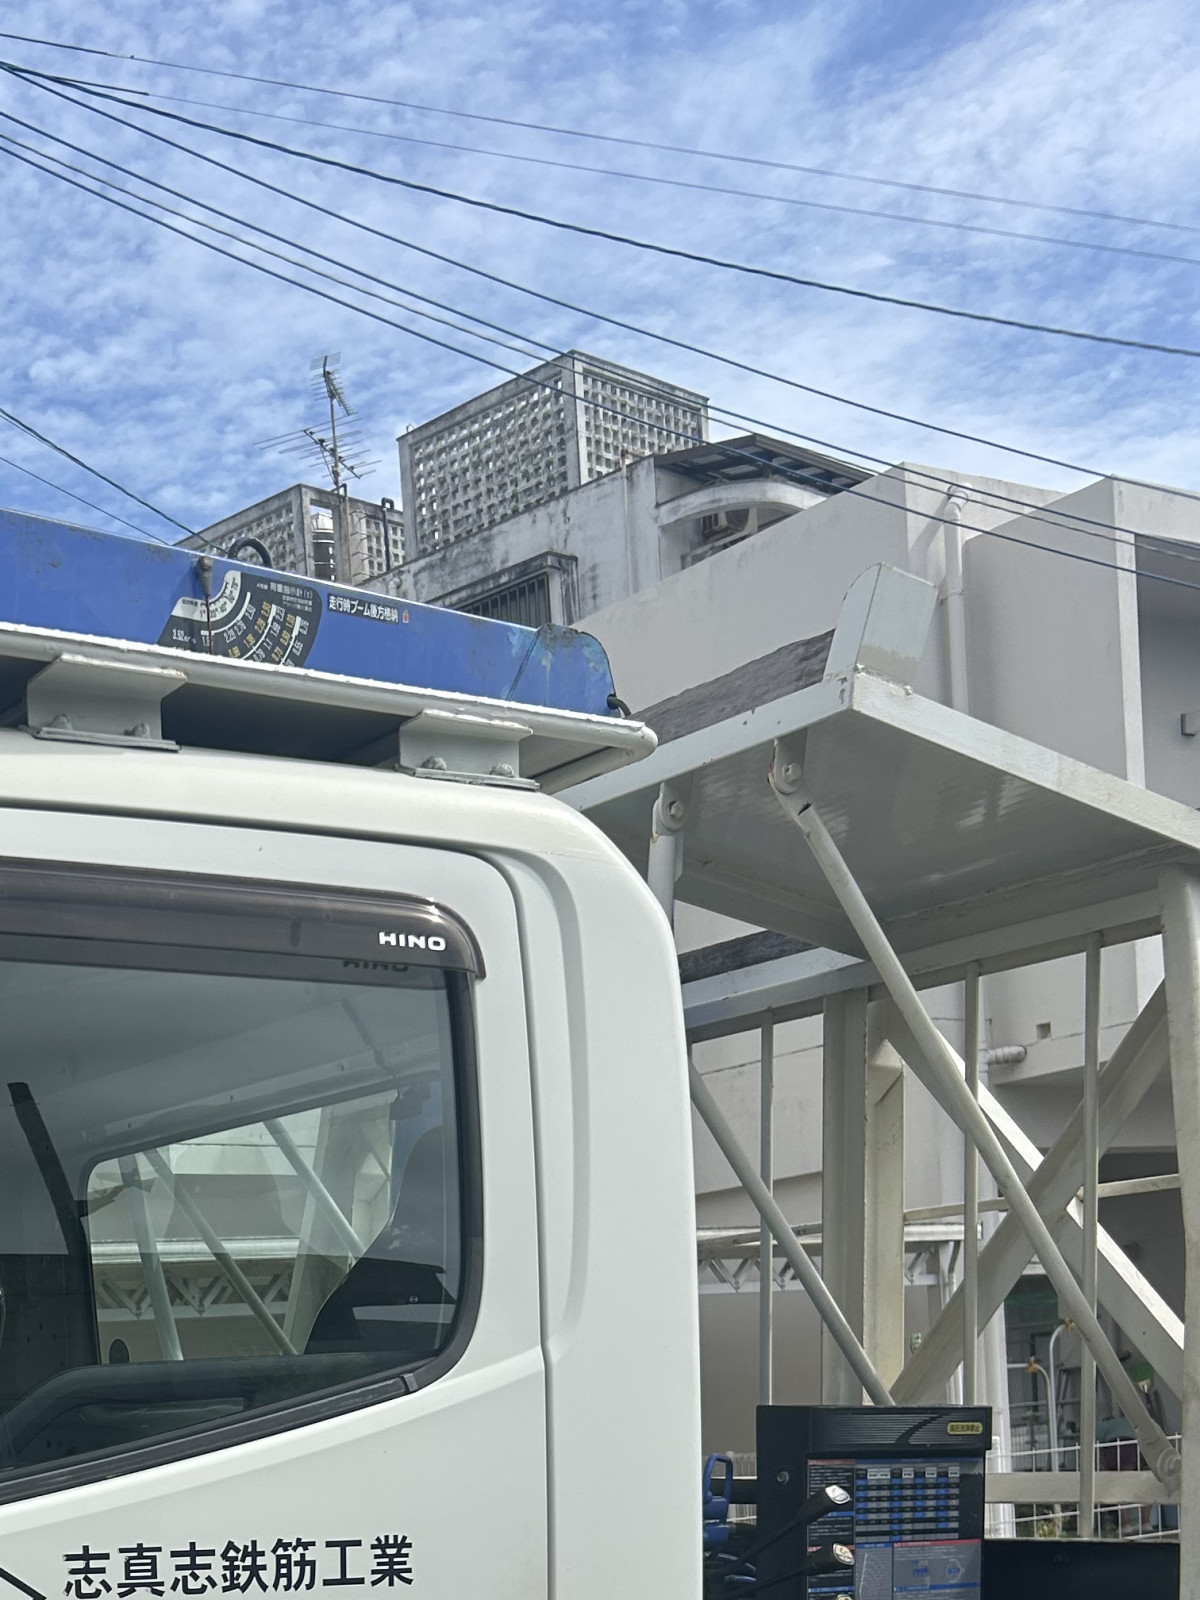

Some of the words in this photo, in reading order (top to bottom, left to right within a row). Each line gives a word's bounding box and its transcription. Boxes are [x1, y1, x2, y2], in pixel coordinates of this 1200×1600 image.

[328, 595, 399, 623] 走行時ブーム後方格納
[378, 931, 446, 951] HINO
[62, 1535, 414, 1599] 志真志鉄筋工業
